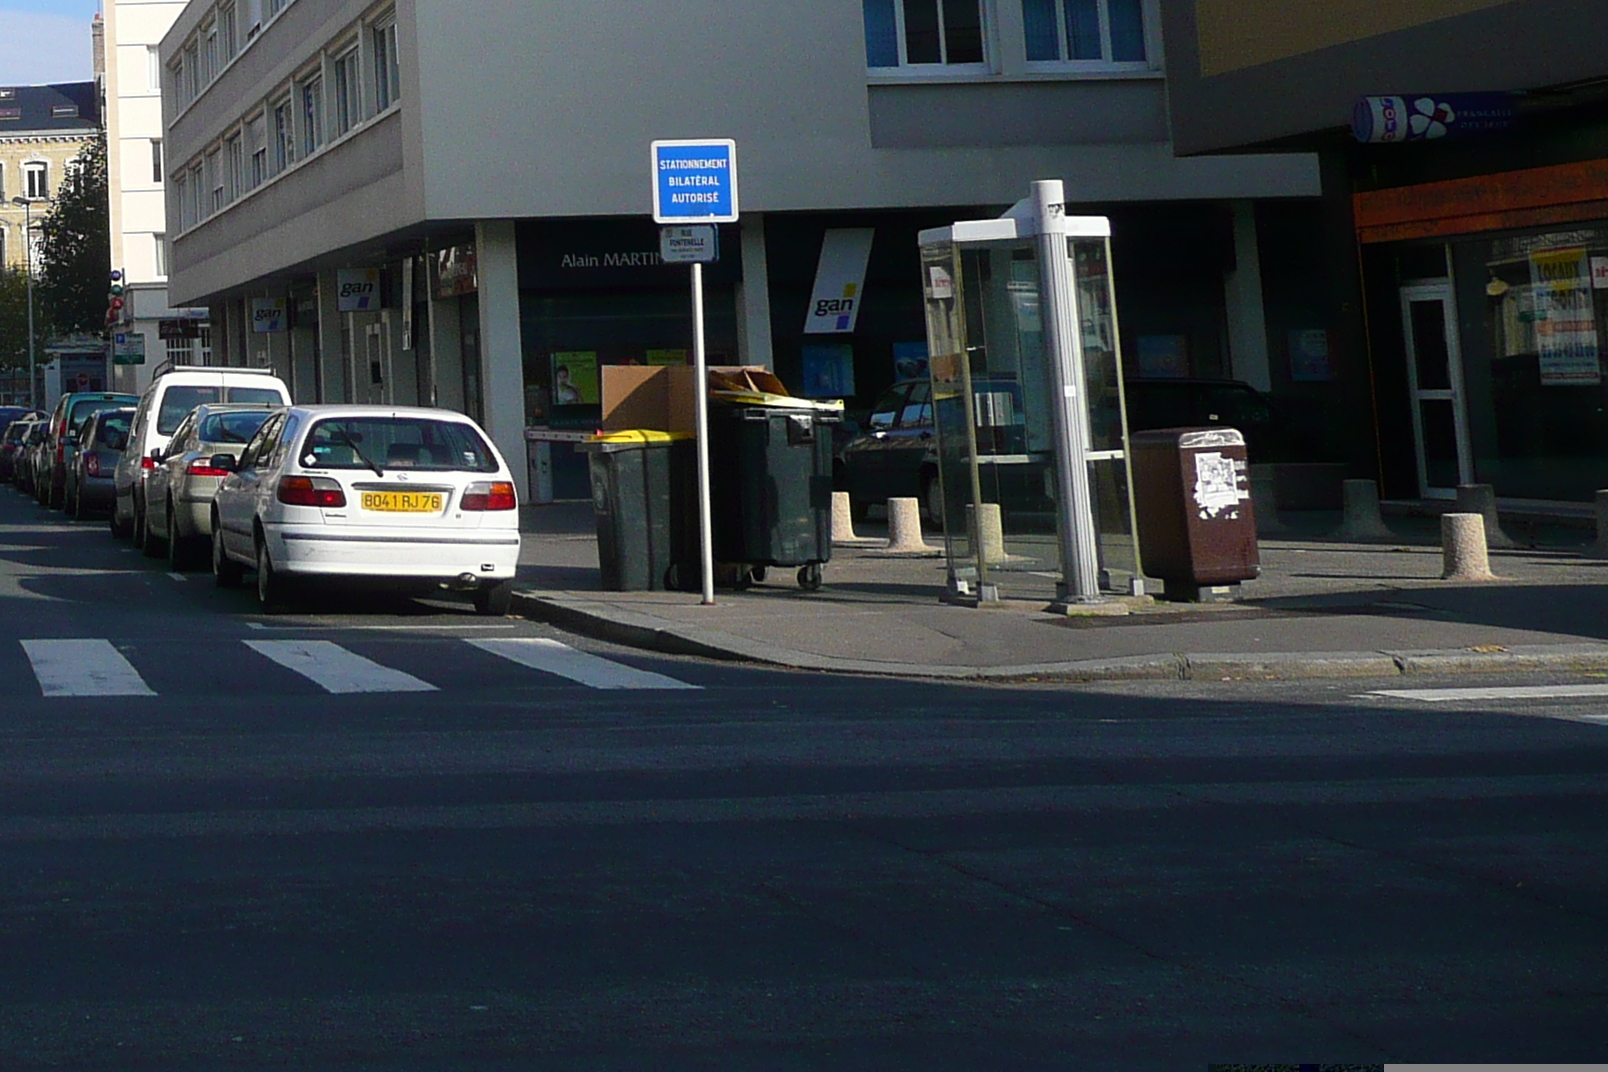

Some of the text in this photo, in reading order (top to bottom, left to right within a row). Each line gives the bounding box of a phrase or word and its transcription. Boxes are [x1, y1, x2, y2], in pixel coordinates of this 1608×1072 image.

[660, 159, 727, 170] STATIONNEMENT
[668, 175, 720, 187] BILATÉRAL
[671, 192, 720, 203] AUTORISÉ
[560, 254, 599, 268] Alain
[340, 282, 373, 297] gan
[815, 299, 853, 316] gan
[254, 309, 281, 321] gan
[363, 493, 440, 510] 8041 RJ 76
